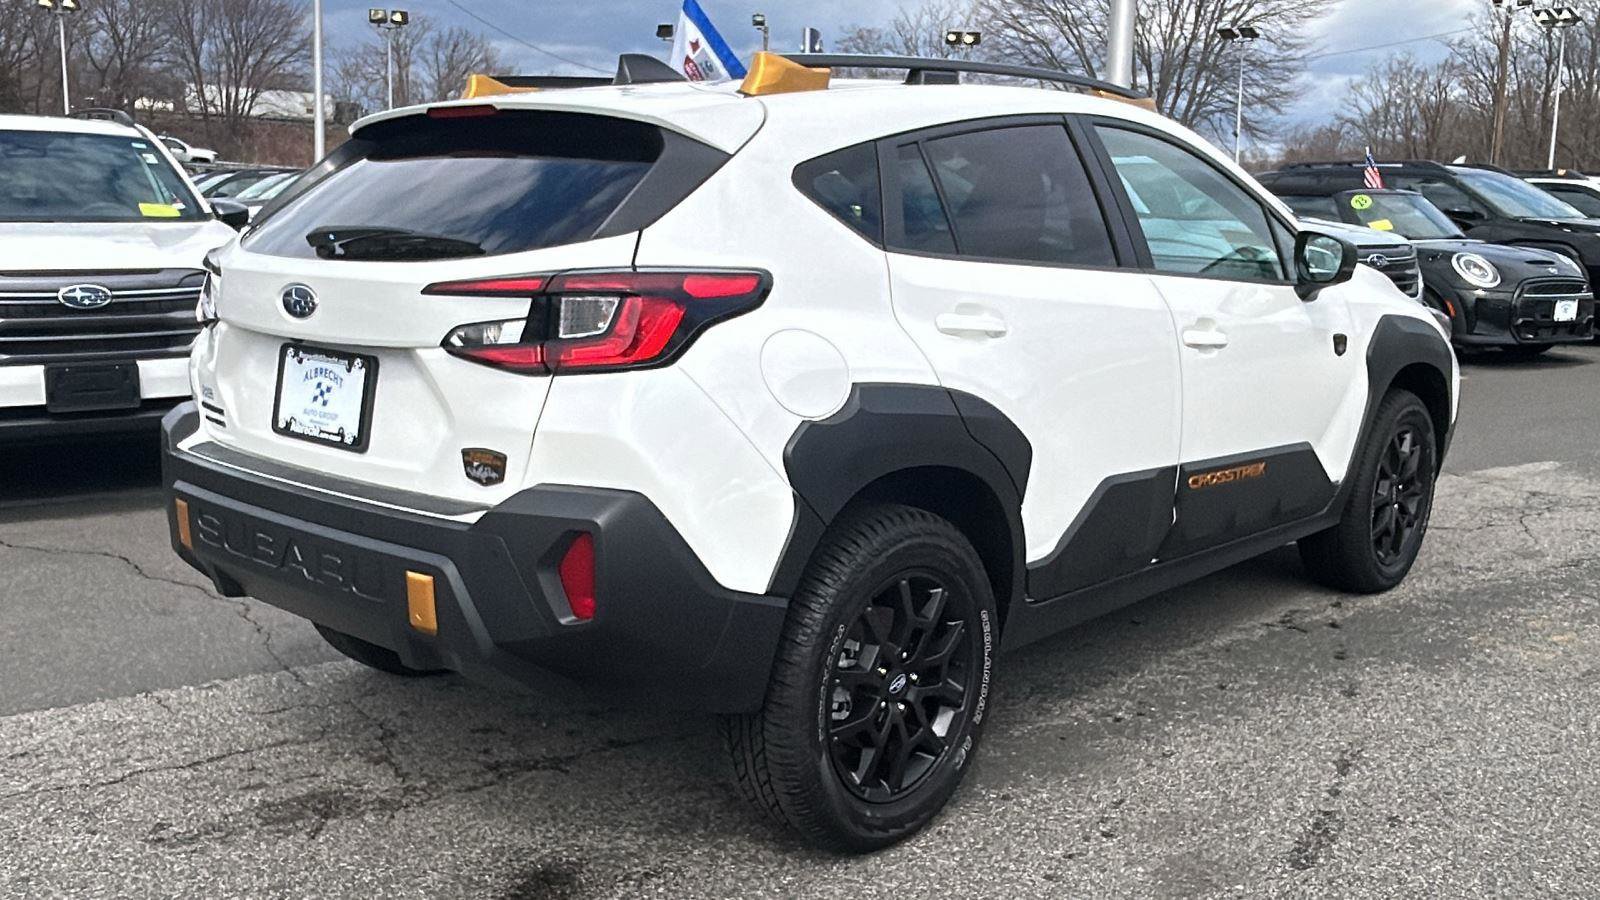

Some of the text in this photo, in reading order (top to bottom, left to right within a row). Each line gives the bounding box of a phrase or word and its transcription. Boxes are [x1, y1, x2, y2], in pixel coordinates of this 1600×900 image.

[303, 366, 344, 389] ALBRECHT
[1188, 461, 1266, 489] CROSSTREK
[196, 513, 386, 603] SUBARU
